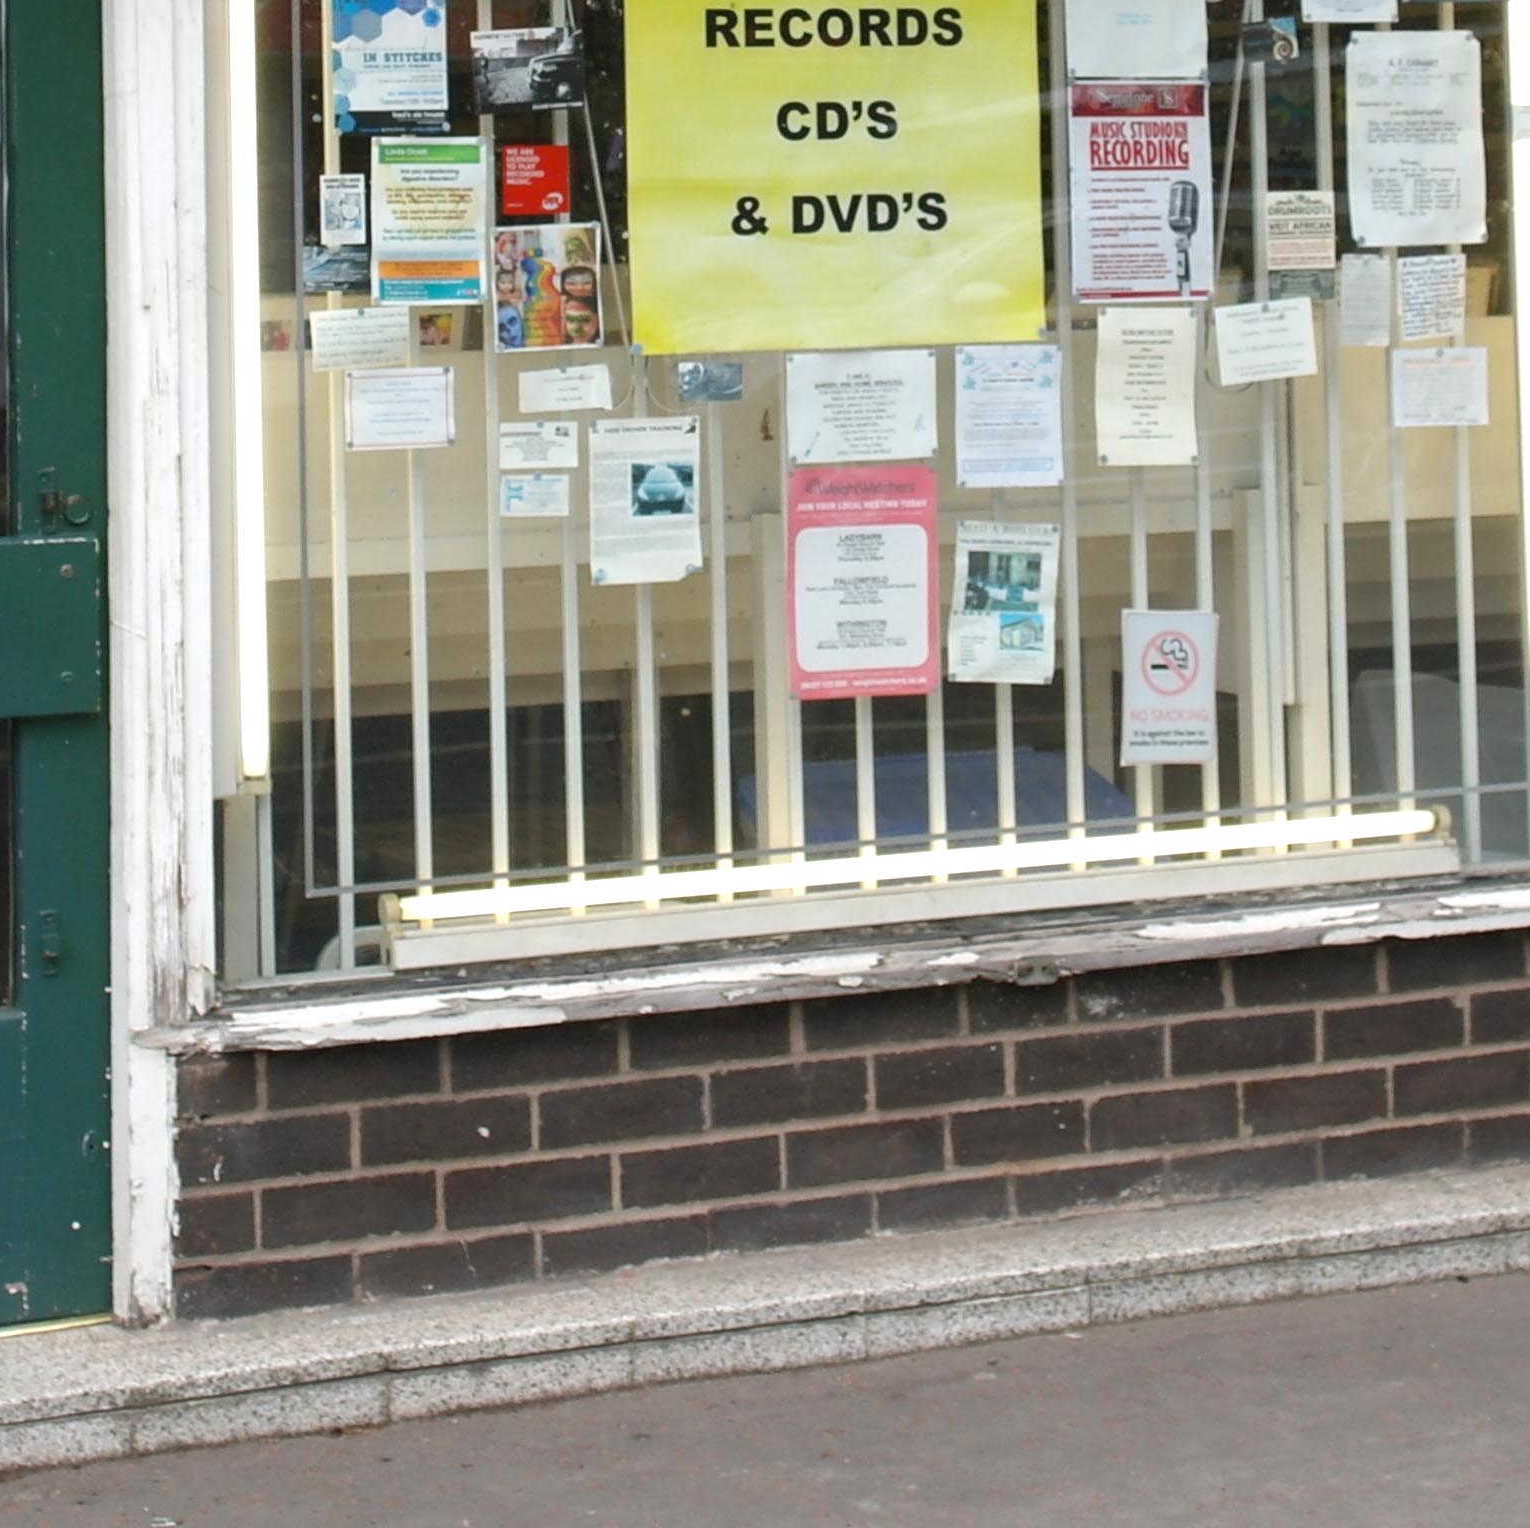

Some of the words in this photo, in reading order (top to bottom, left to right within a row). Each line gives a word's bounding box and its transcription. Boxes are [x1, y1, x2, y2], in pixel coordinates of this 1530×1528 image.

[705, 7, 964, 48] RECORDS
[384, 52, 442, 62] STITCHES
[776, 100, 899, 141] CD'S
[1090, 121, 1126, 138] MUSIC
[1130, 121, 1174, 139] STUDIO
[1090, 139, 1189, 165] RECORDING
[731, 197, 770, 236] &
[792, 193, 949, 234] DVD'S
